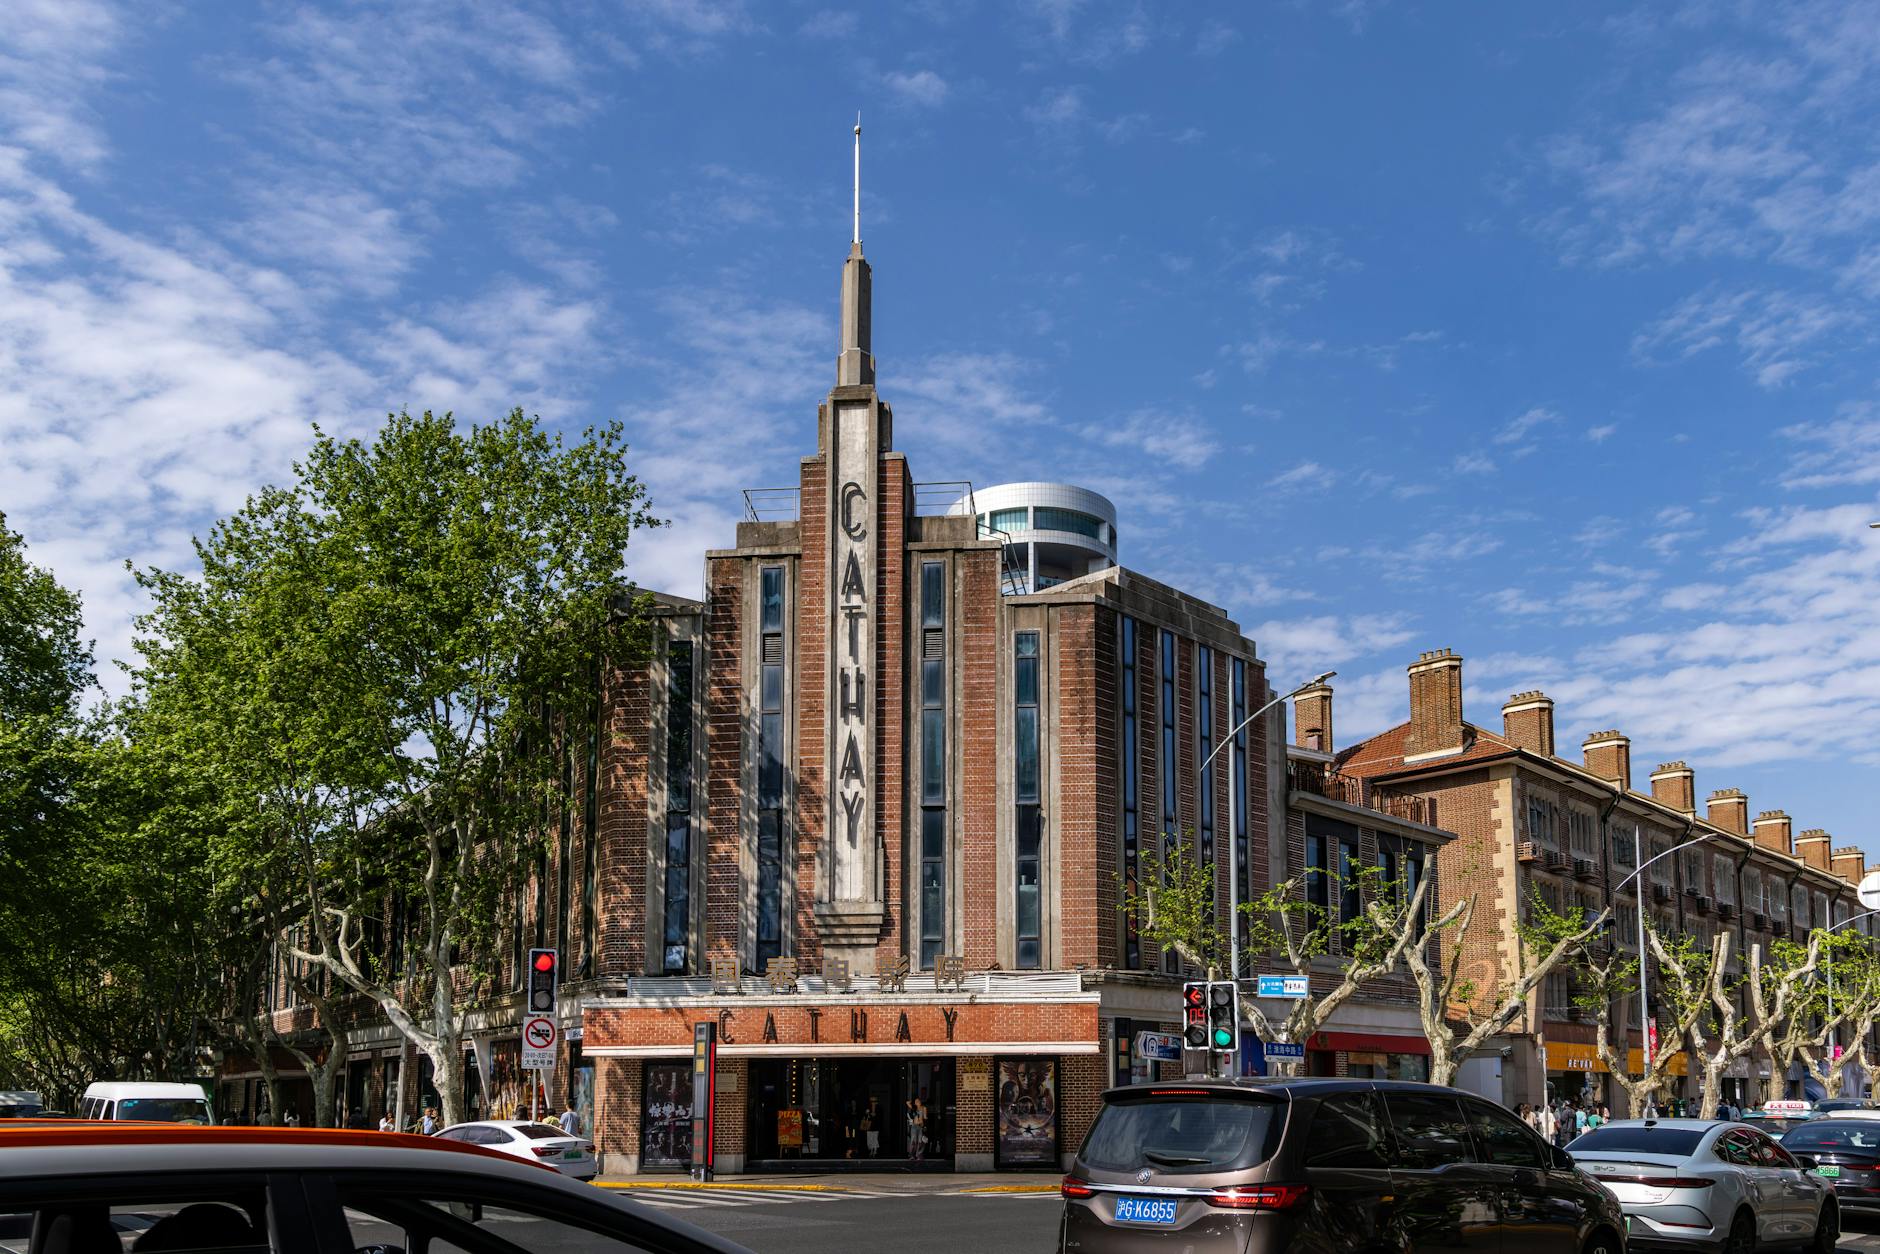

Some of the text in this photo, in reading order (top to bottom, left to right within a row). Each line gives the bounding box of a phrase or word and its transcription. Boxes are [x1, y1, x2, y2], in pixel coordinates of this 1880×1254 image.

[840, 481, 865, 849] CATHAY
[711, 955, 966, 988] 国泰电影院
[718, 1007, 958, 1044] CATHAY
[1189, 1008, 1206, 1024] 05
